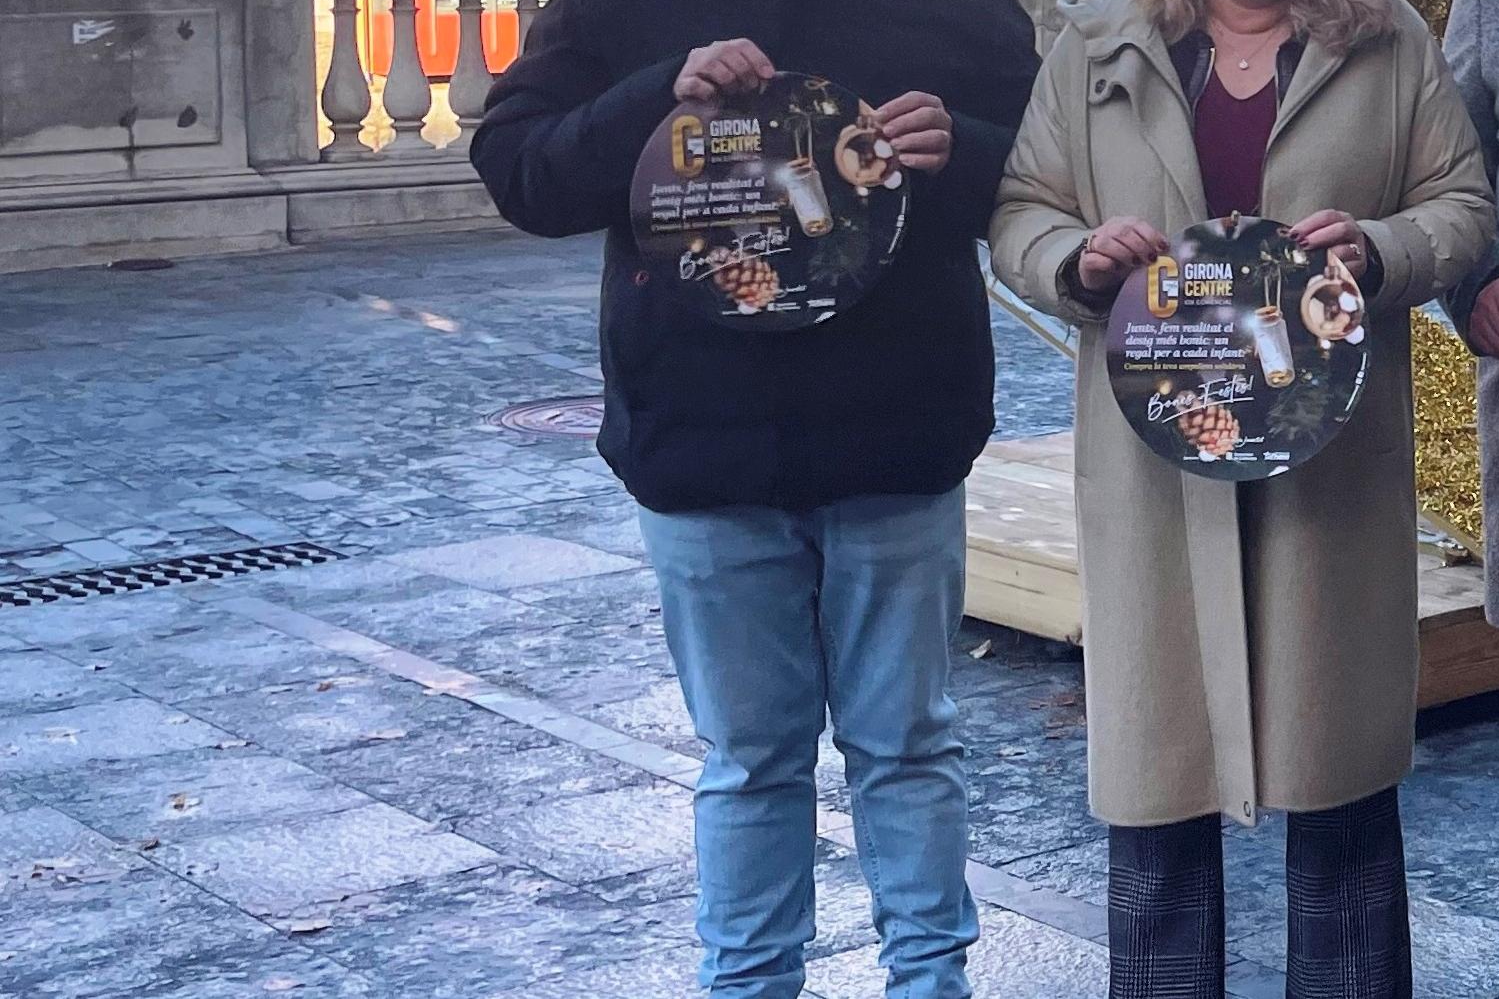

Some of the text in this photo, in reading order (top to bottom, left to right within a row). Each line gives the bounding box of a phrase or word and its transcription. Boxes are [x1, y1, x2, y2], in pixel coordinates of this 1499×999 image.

[709, 118, 761, 137] GIRONA
[711, 136, 762, 154] CENTRE
[1184, 263, 1233, 280] GIRONA
[1184, 280, 1233, 297] CENTRE
[1158, 322, 1180, 335] fem
[1182, 322, 1222, 333] realitat
[1223, 322, 1234, 333] el
[1155, 335, 1178, 346] més
[1214, 337, 1229, 346] un
[1125, 347, 1152, 361] regal
[1153, 350, 1173, 360] per
[1173, 350, 1181, 358] a
[1182, 347, 1208, 358] cada
